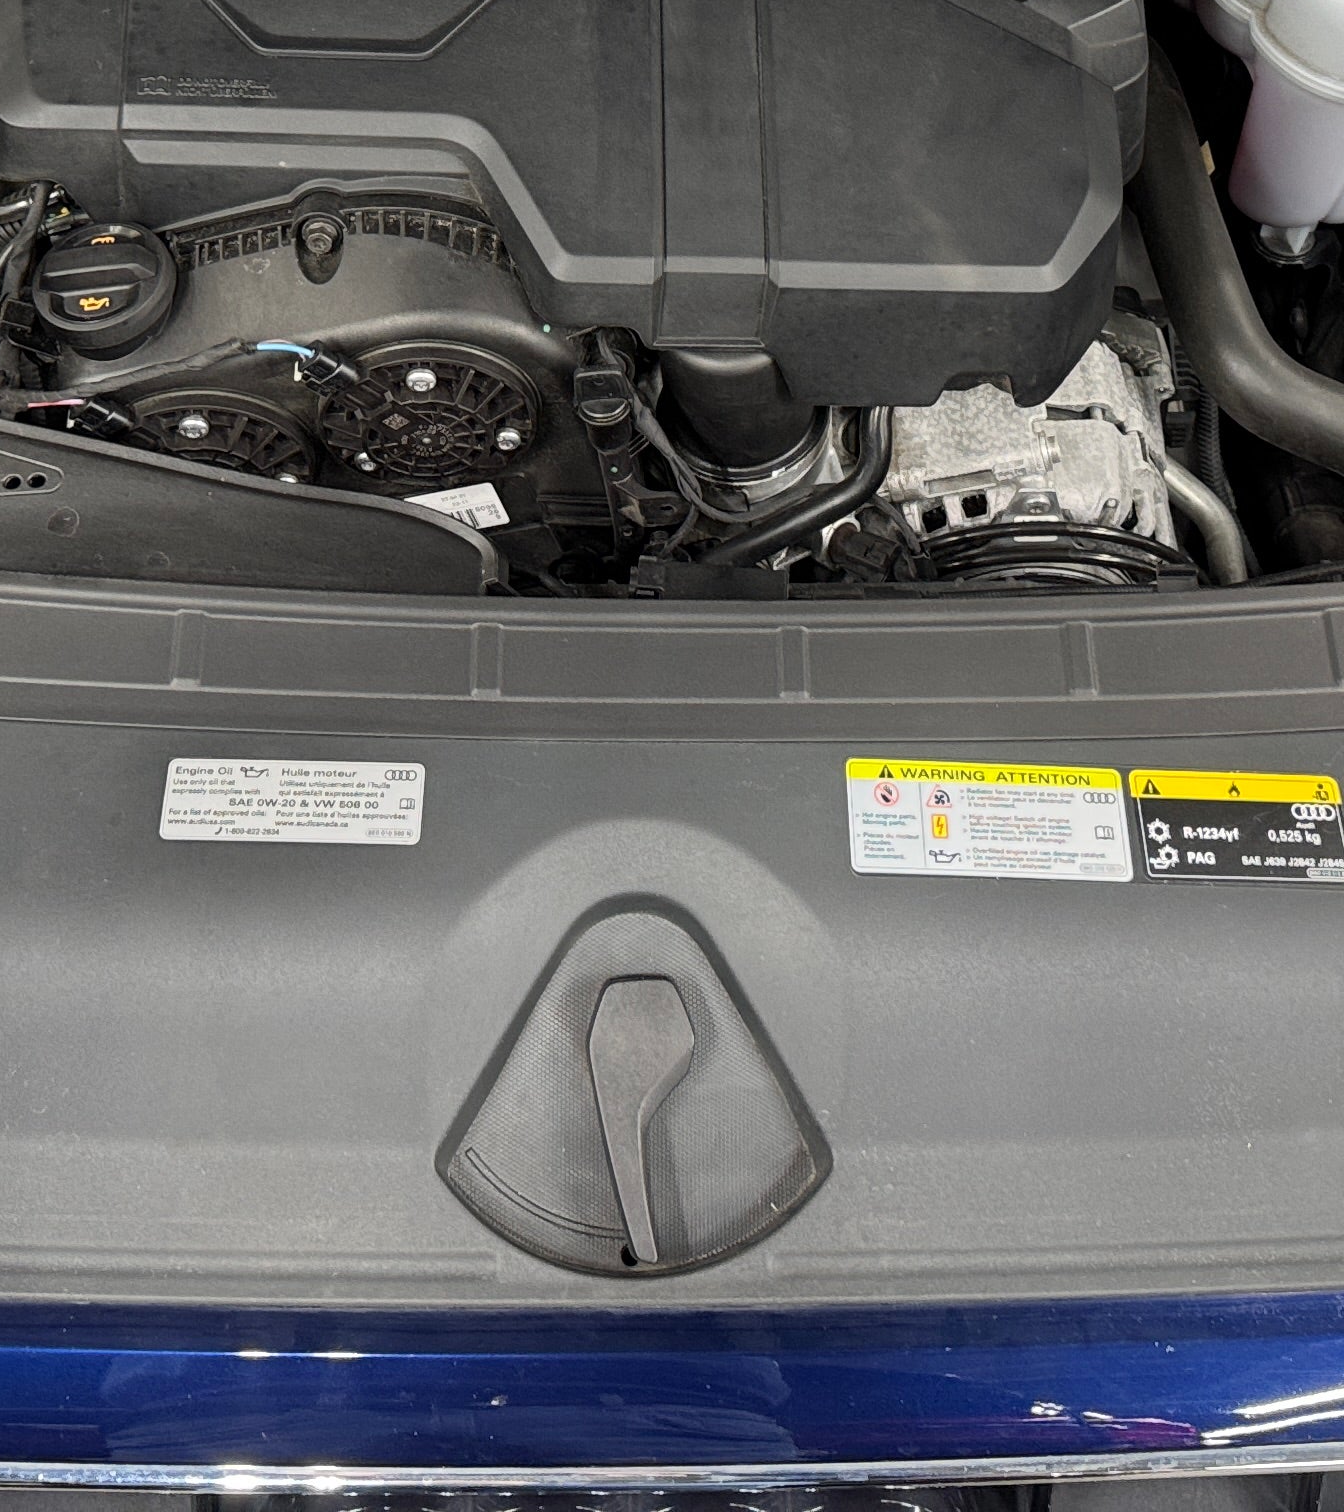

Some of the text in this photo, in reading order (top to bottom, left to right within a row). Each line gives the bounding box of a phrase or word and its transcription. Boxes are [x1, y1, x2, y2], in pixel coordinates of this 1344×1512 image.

[176, 766, 233, 776] Engine Oil
[282, 768, 358, 778] Huile moteur
[900, 767, 1091, 786] WARNING ATTENTION
[190, 778, 207, 787] only
[220, 778, 236, 786] that
[229, 798, 254, 807] SAE
[257, 798, 296, 808] 0W-20
[300, 800, 309, 808] &
[314, 800, 336, 808] VW
[364, 801, 379, 809] 00
[203, 808, 211, 816] of
[1183, 826, 1240, 842] R-1234yf
[1268, 829, 1322, 845] 0,525 kg
[1187, 852, 1217, 866] PAG
